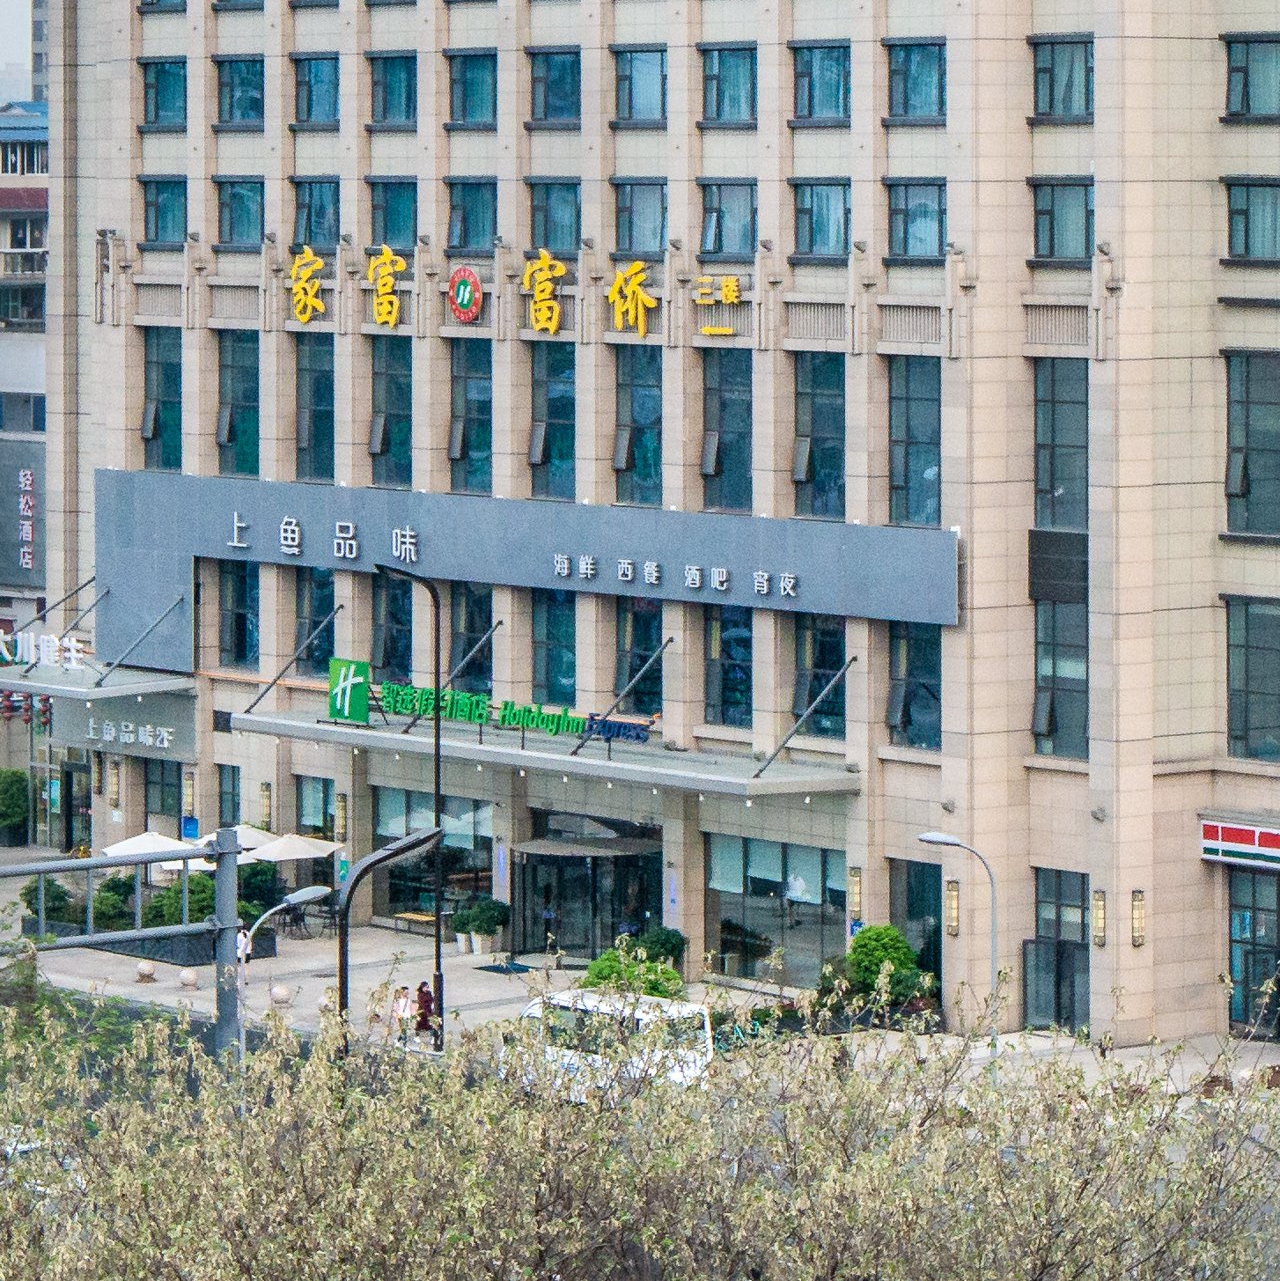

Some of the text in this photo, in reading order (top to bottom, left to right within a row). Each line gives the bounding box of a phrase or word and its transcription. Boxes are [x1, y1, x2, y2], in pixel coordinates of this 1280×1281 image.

[18, 469, 35, 570] 轻松酒店
[227, 511, 419, 563] 上鱼品味
[554, 553, 797, 597] 海鲜 西餐 酒吧 宵夜
[499, 701, 560, 736] Holiday
[560, 707, 586, 734] Inn
